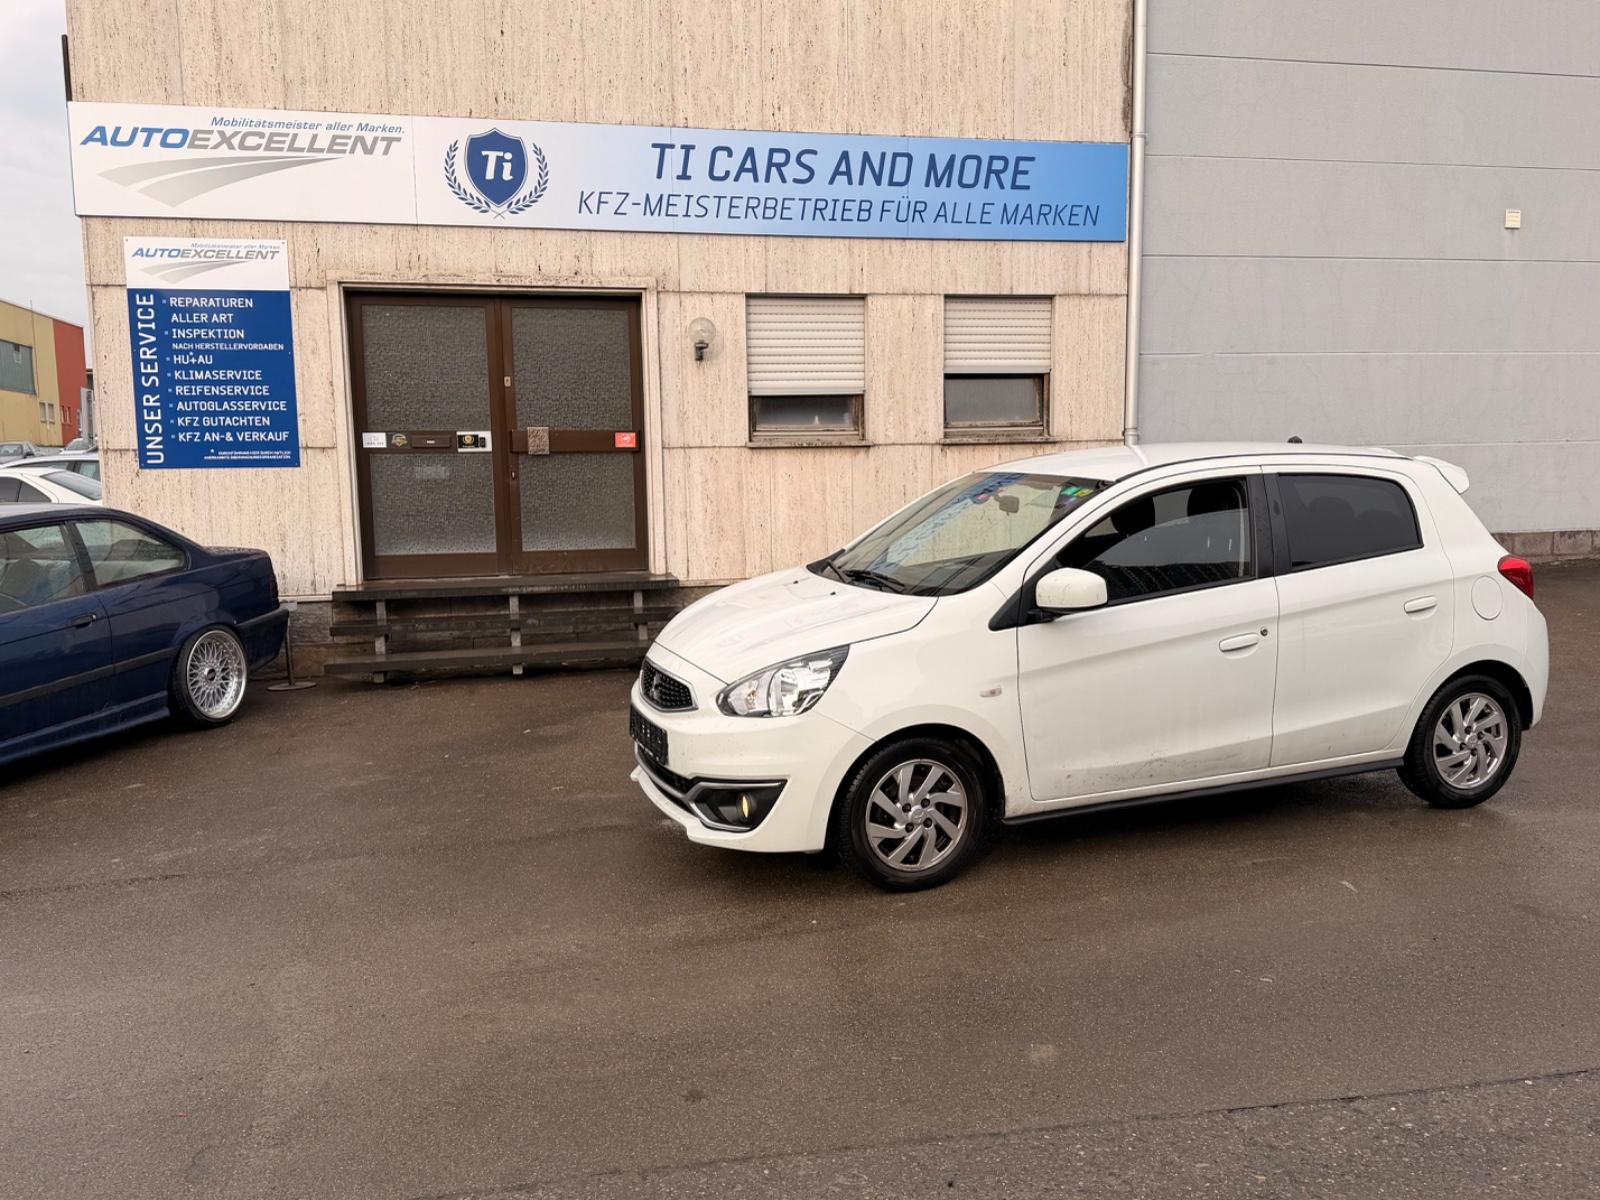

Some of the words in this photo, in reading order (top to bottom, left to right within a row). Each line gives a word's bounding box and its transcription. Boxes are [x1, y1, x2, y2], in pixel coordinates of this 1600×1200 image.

[325, 121, 353, 132] aller
[357, 122, 405, 134] Marken.
[80, 125, 402, 156] AUTOEXCELLENT
[481, 150, 514, 180] Ti
[651, 142, 696, 181] TI
[707, 145, 818, 185] CARS
[827, 150, 914, 187] AND
[924, 153, 1036, 191] MORE
[578, 190, 874, 222] KFZ-MEISTERBETRIEB
[879, 195, 928, 224] FÜR
[932, 201, 995, 225] ALLE
[1000, 203, 1100, 227] MARKEN
[169, 297, 254, 308] REPARATUREN
[171, 313, 208, 324] ALLER
[211, 313, 234, 324] ART
[172, 328, 245, 339] INSPEKTION
[136, 294, 159, 387] SERVICE
[172, 342, 194, 351] NACH
[174, 370, 262, 381] KLIMASERVICE
[175, 385, 270, 396] REIFENSERVICE
[176, 400, 287, 411] AUTOGLASSERVICE
[177, 416, 200, 427] KFZ
[202, 416, 270, 427] GUTACHTEN
[143, 394, 165, 464] UNSER
[178, 431, 201, 442] KFZ
[236, 431, 289, 442] VERKAUF
